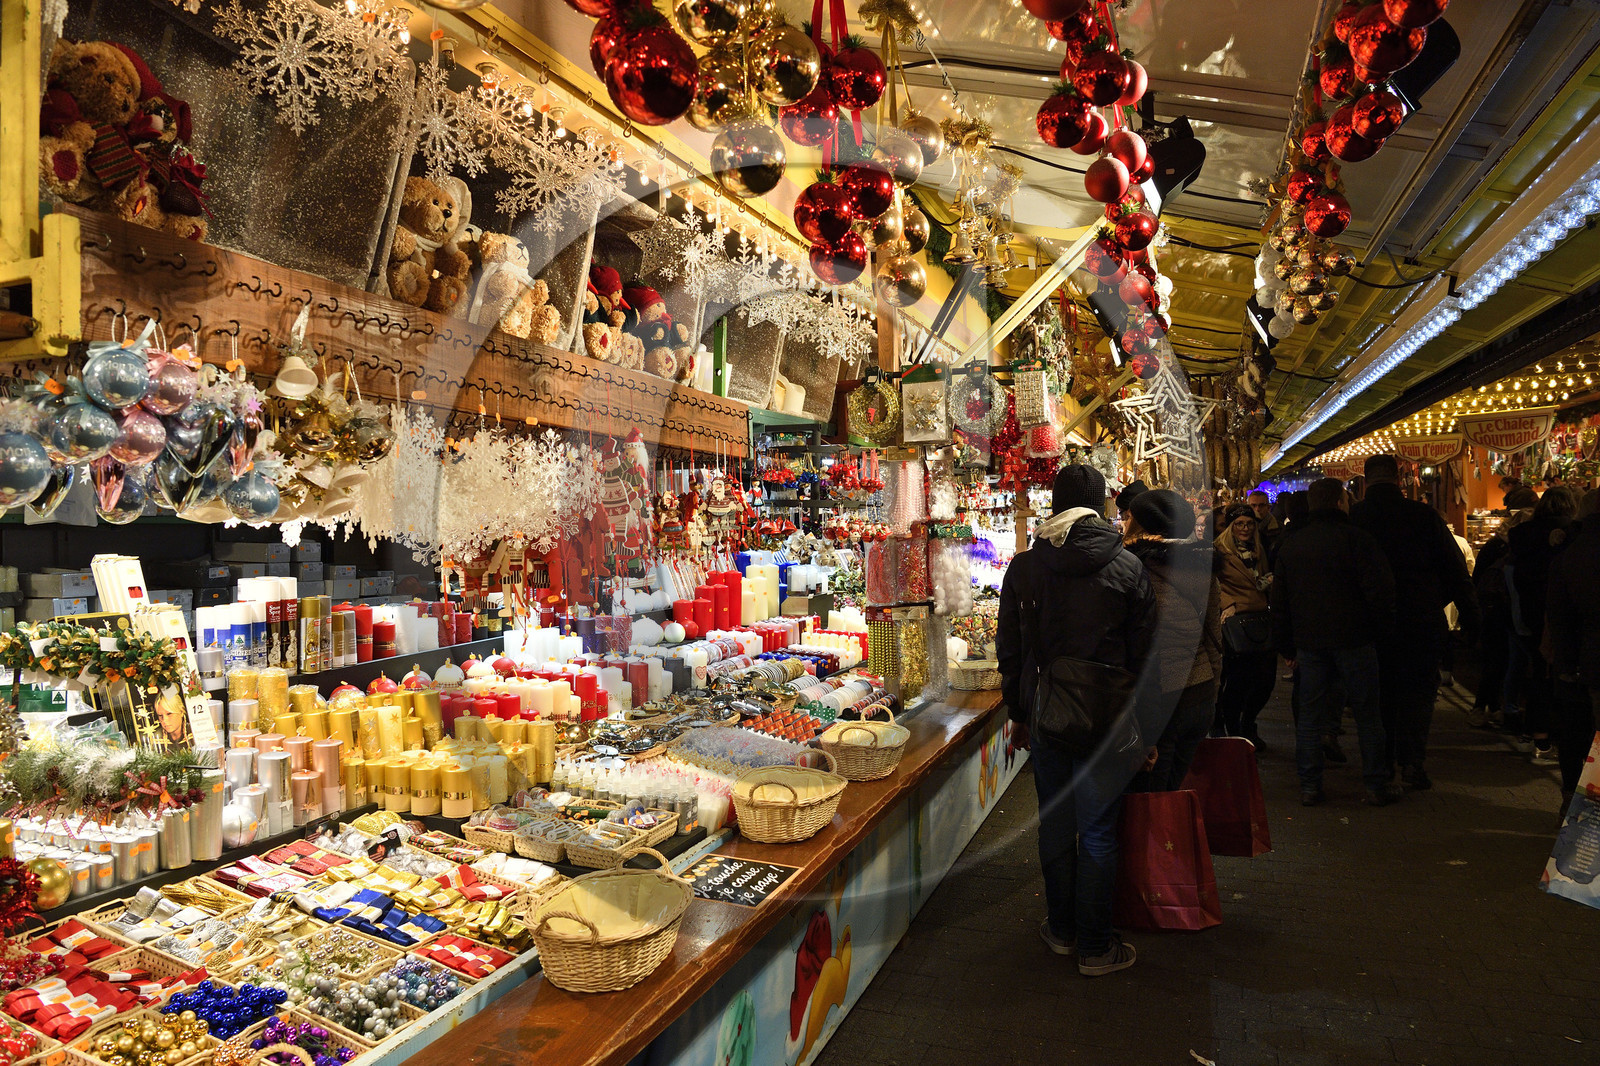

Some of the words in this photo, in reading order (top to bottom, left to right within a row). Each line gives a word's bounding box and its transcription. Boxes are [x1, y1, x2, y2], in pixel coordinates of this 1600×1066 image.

[1478, 422, 1494, 434] Le
[1495, 417, 1536, 432] Chalet
[1474, 427, 1540, 446] Gourmand
[1400, 444, 1420, 457] Pain
[1422, 442, 1456, 458] d'épices
[192, 704, 204, 714] 12
[750, 872, 779, 894] paye
